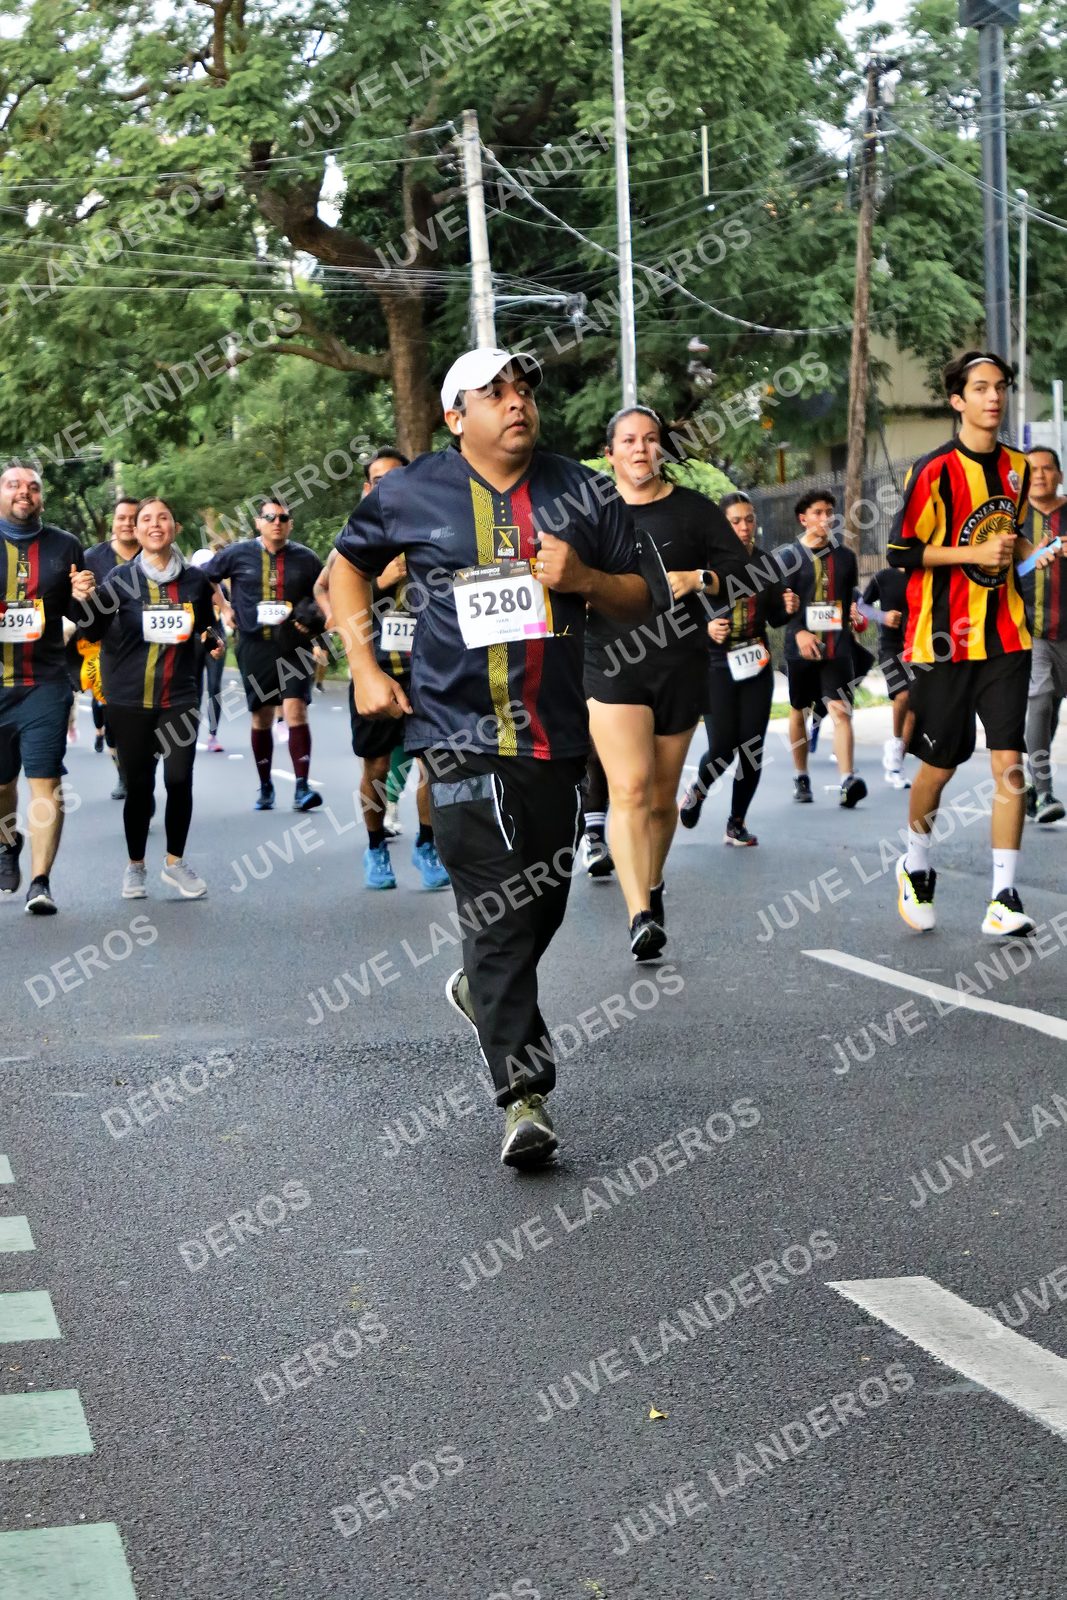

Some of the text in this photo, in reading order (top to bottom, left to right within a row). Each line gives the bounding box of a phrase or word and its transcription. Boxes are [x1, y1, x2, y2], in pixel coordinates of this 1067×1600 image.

[960, 502, 996, 542] LEONES
[469, 586, 532, 619] 5280
[150, 615, 183, 629] 3395
[386, 622, 415, 636] 1212
[735, 649, 762, 666] 1170
